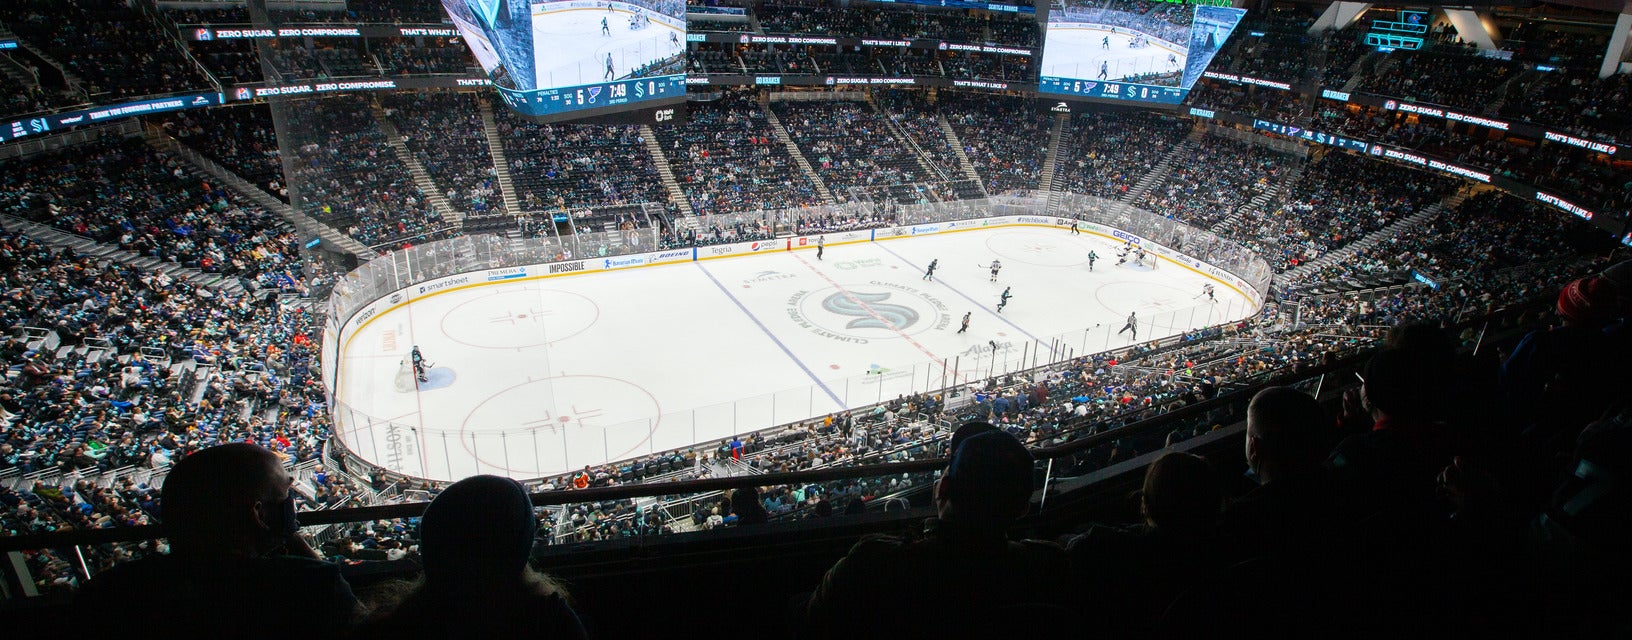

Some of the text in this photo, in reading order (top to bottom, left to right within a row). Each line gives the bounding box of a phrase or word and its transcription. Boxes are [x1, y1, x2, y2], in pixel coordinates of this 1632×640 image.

[217, 30, 241, 38] ZERO
[997, 47, 1032, 56] COMPROMISE.
[1219, 73, 1239, 81] SUGAR.
[256, 81, 396, 96] ZERO SUGAR. ZERO COMPROMISE.
[610, 84, 626, 98] 7:49
[649, 81, 654, 96] 0
[1074, 82, 1080, 92] 5
[1103, 83, 1120, 94] 7:49
[1141, 88, 1148, 98] 0
[577, 90, 584, 104] 5
[1331, 90, 1350, 101] KRAKEN
[89, 111, 110, 120] THANK
[152, 100, 184, 110] PARTNERS
[1398, 103, 1509, 130] ZERO SUGAR. ZERO COMPROMISE.
[1545, 131, 1566, 143] THAT'S
[1567, 135, 1588, 148] WHAT
[1592, 141, 1609, 153] LIKE
[1385, 150, 1404, 160] ZERO
[1404, 153, 1426, 166] SUGAR.
[1429, 160, 1446, 171] ZERO
[1536, 192, 1558, 206] THAT'S
[1558, 199, 1574, 212] WHAT
[1576, 206, 1588, 218] LIKE
[1113, 230, 1140, 244] GEICO
[712, 246, 732, 254] Tegria
[760, 241, 778, 250] pepsi
[550, 262, 584, 274] IMPOSSIBLE
[427, 276, 468, 290] smartsheet
[1216, 270, 1233, 282] HANDS
[870, 280, 919, 292] CLIMATE
[356, 308, 376, 326] verizon
[812, 328, 869, 344] CLIMATE
